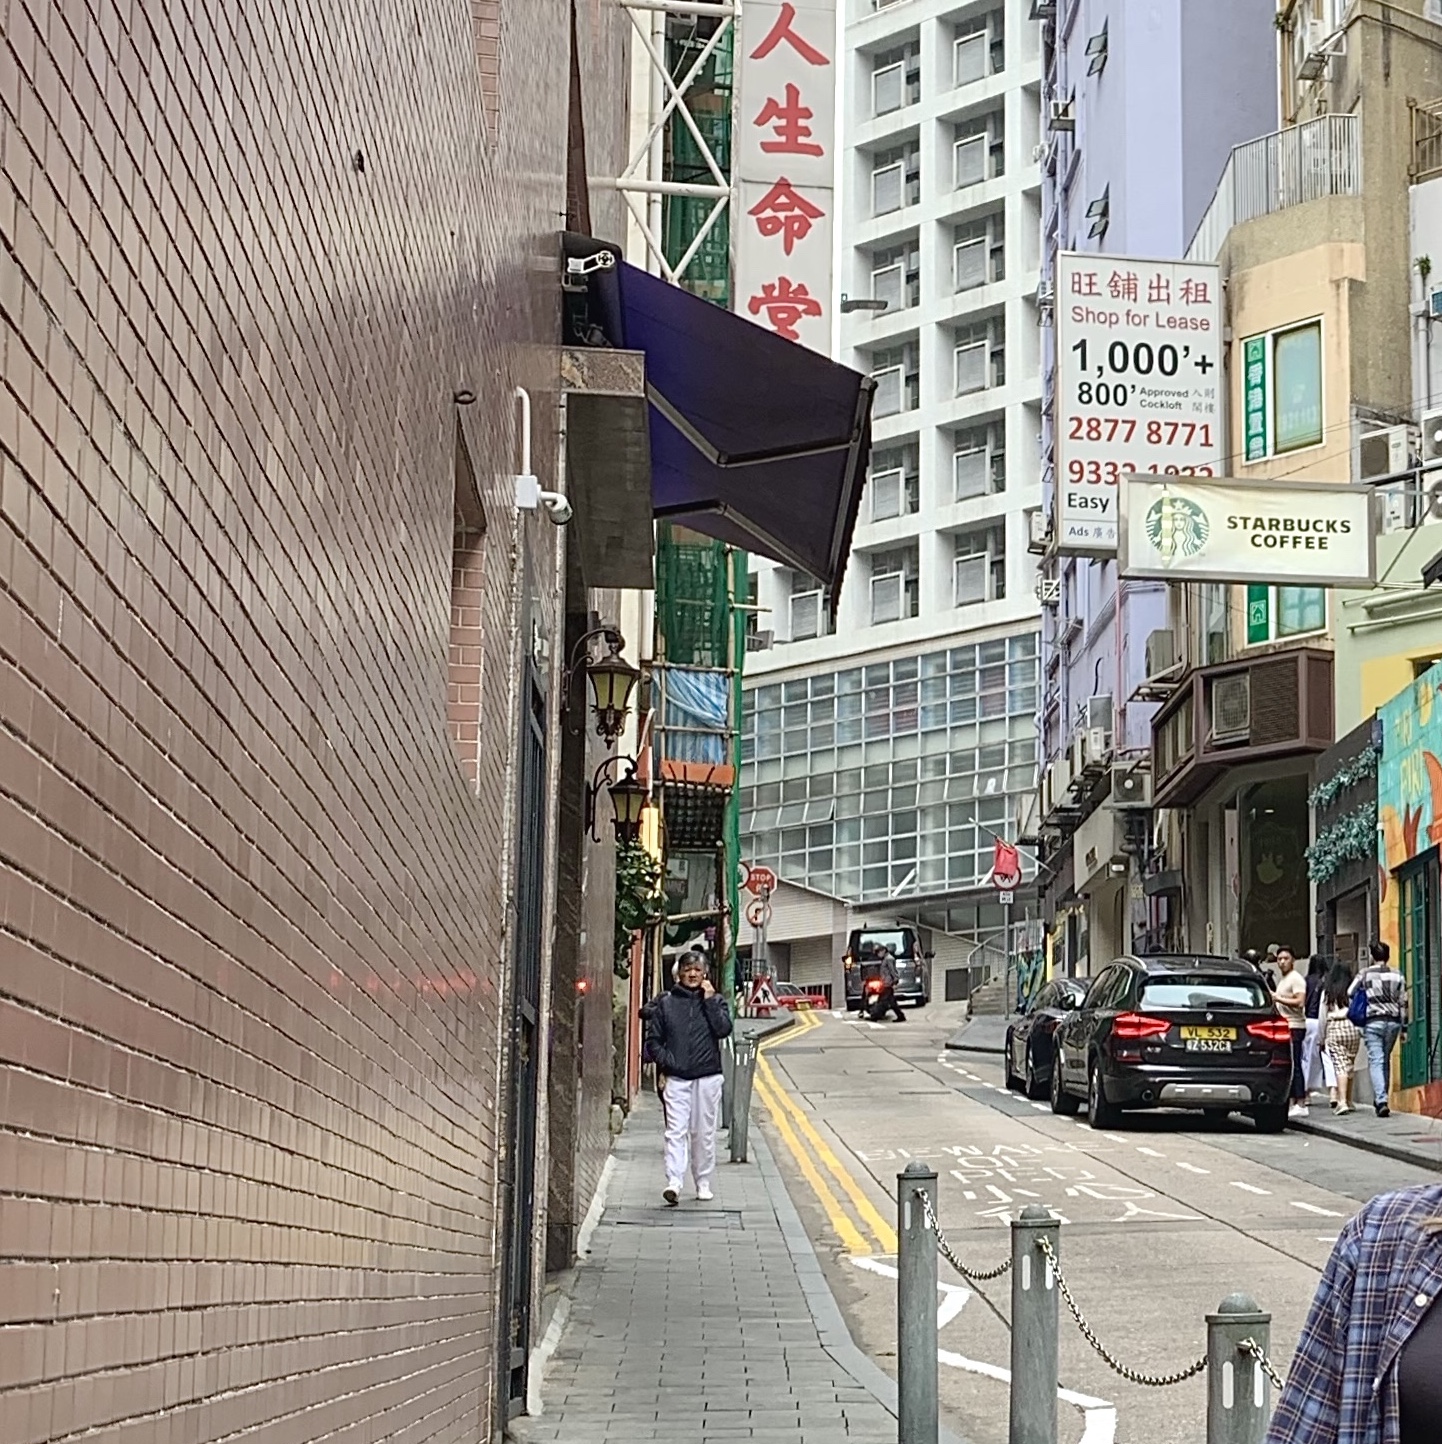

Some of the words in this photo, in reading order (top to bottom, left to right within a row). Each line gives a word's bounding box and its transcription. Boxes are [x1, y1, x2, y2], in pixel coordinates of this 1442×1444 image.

[1071, 306, 1119, 328] Shop
[1126, 309, 1149, 327] for
[1156, 312, 1210, 331] Lease
[1140, 387, 1189, 399] Approved
[1140, 400, 1182, 410] Cockloft
[1069, 416, 1136, 443] 2877
[1147, 420, 1214, 447] 8771
[1068, 493, 1109, 513] Easy
[1227, 516, 1351, 534] STARBUCKS
[1069, 527, 1089, 537] Ads
[1251, 535, 1329, 550] COFFEE
[751, 874, 771, 882] STOP
[1188, 1027, 1201, 1038] VL
[1207, 1028, 1230, 1038] 532
